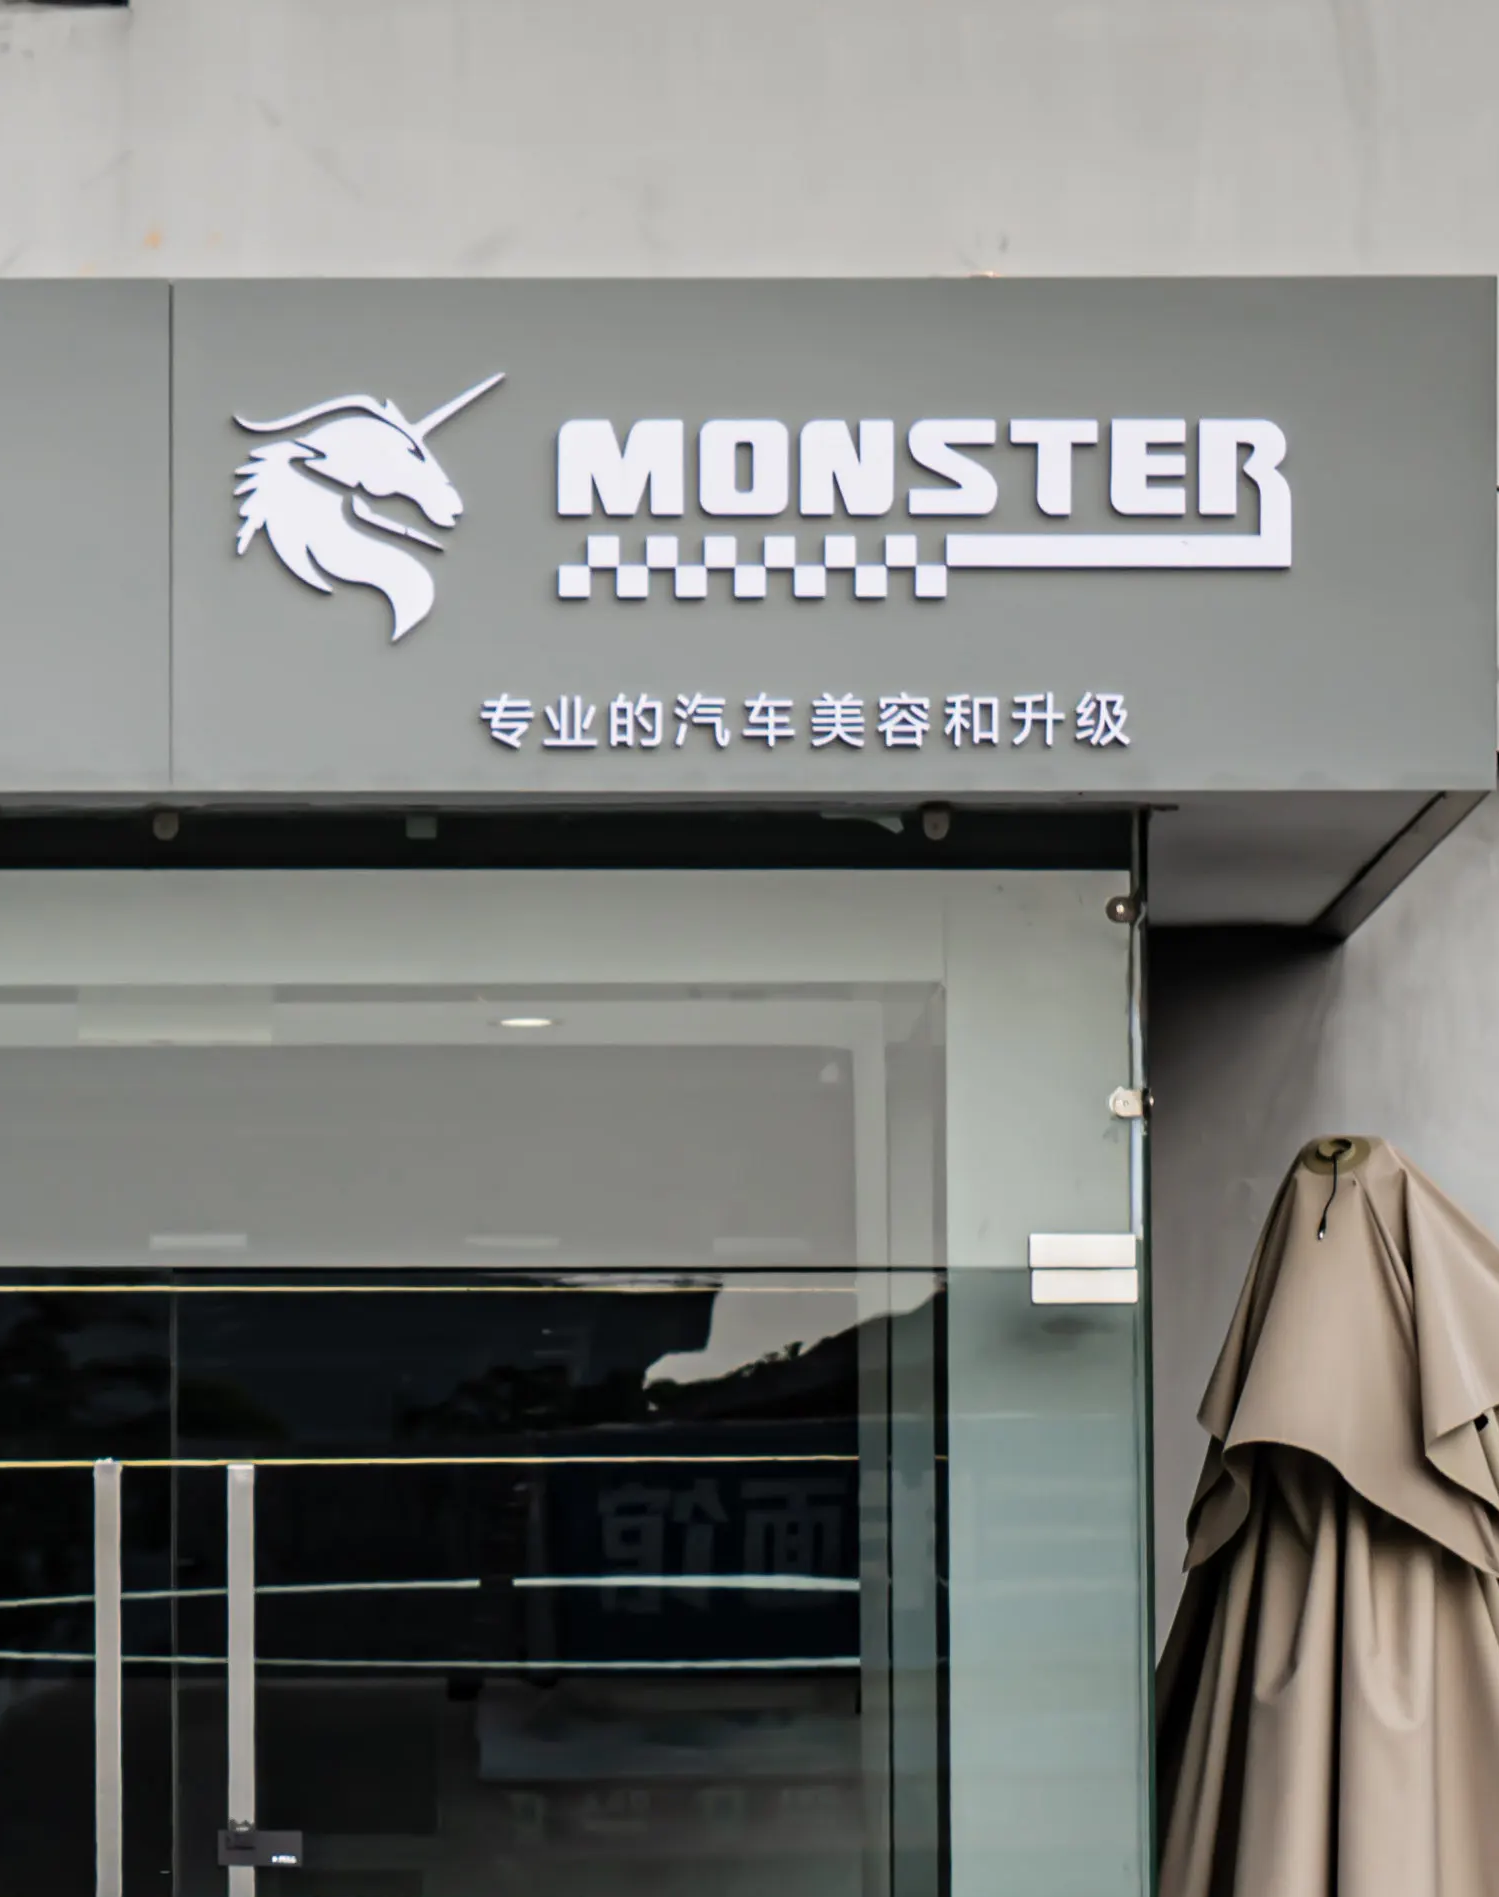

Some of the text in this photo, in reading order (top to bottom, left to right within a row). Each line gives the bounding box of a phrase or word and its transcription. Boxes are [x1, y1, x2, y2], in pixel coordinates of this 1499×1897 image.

[558, 419, 1292, 567] MONSTER
[480, 691, 1131, 748] 专业的汽车美容和升级
